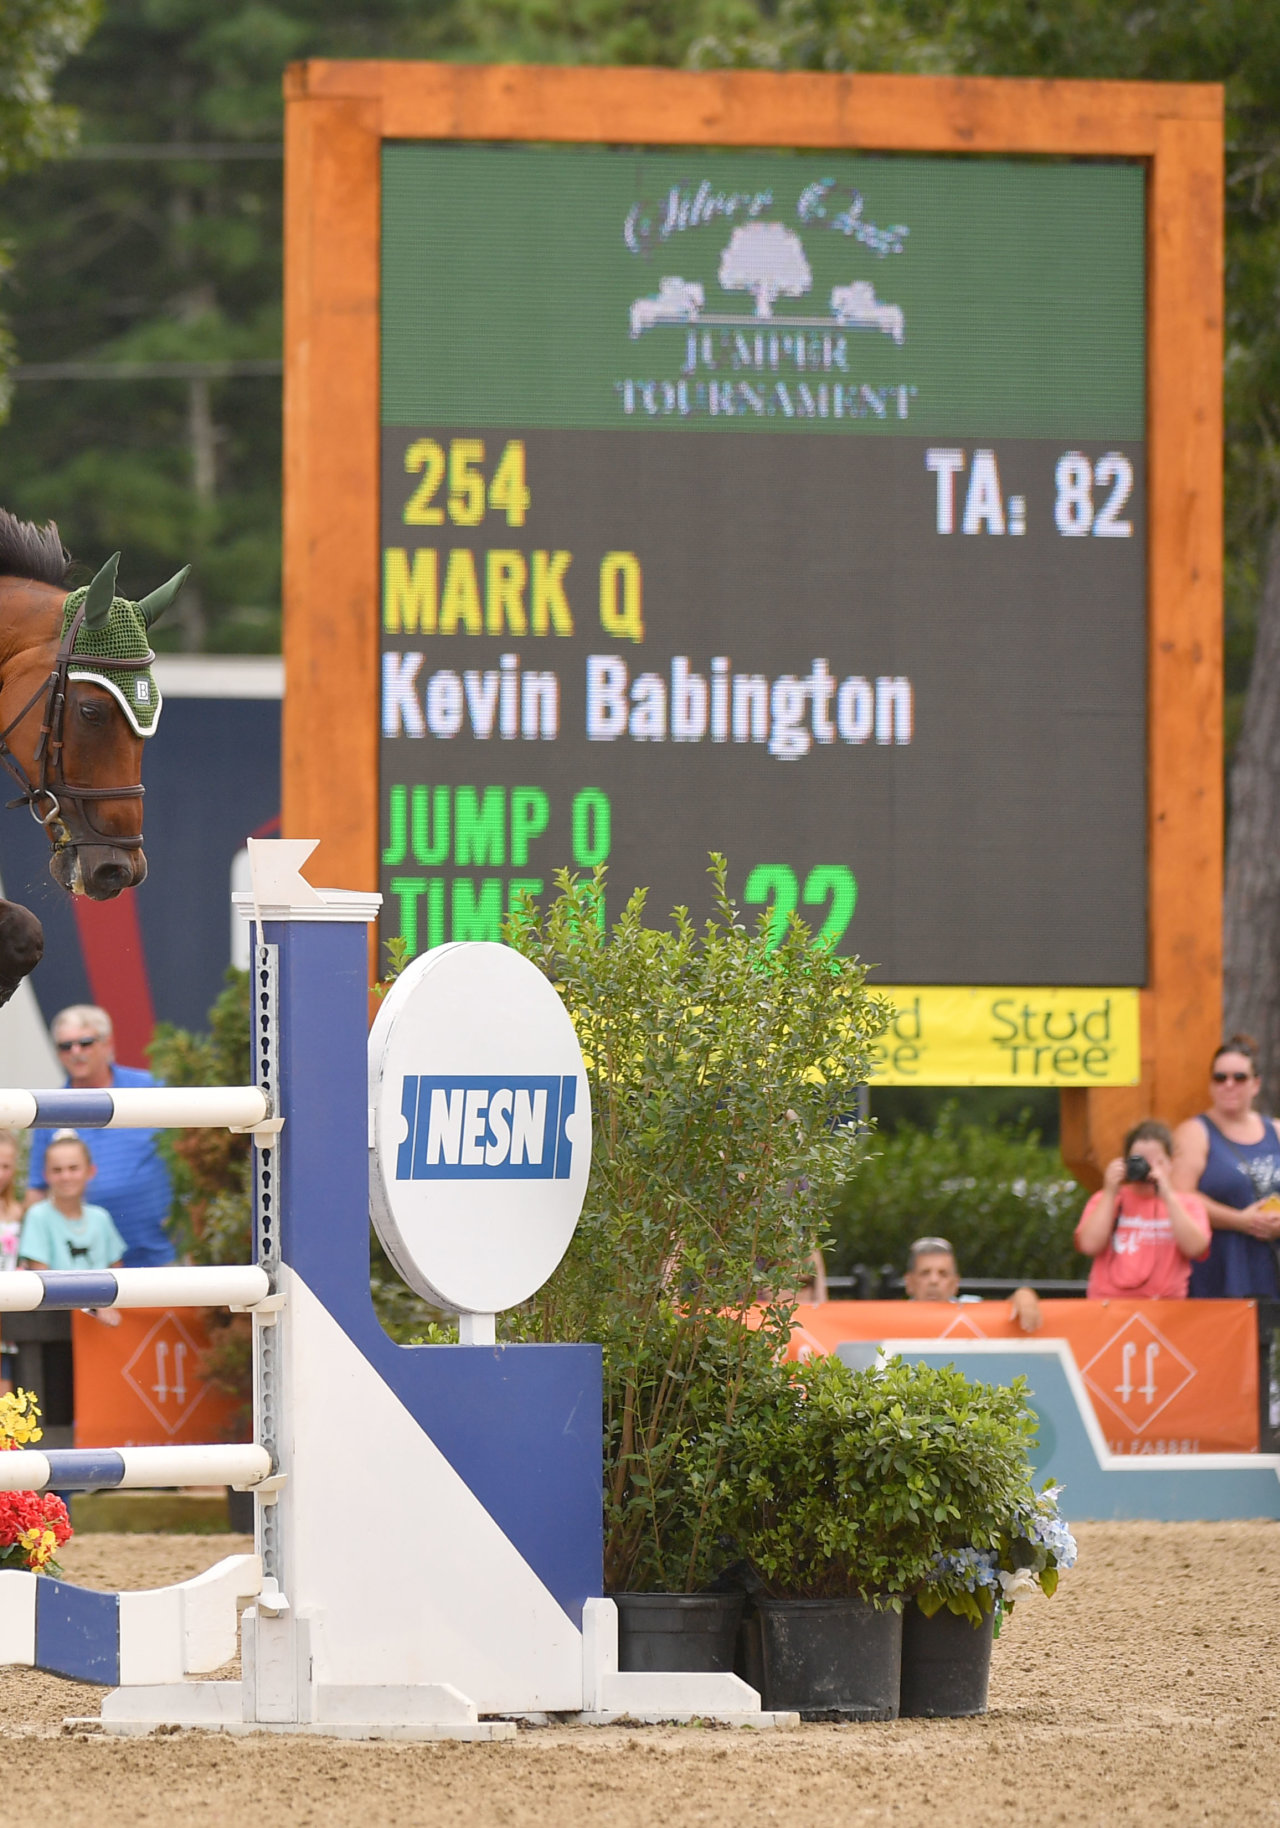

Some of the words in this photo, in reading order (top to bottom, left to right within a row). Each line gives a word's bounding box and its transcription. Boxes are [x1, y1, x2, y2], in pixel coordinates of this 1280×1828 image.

[615, 379, 918, 419] TOURNAMENT
[402, 438, 531, 527] 254
[925, 447, 1027, 536] TA:
[1054, 450, 1134, 538] 82
[383, 547, 574, 637] MARK
[599, 551, 644, 643] Q
[382, 651, 559, 740] Kevin
[586, 654, 914, 761] Babington
[382, 784, 550, 866] JUMP
[744, 863, 859, 977] 22
[991, 997, 1111, 1044] Stud
[1000, 1044, 1110, 1077] Tree
[426, 1088, 548, 1167] NESN
